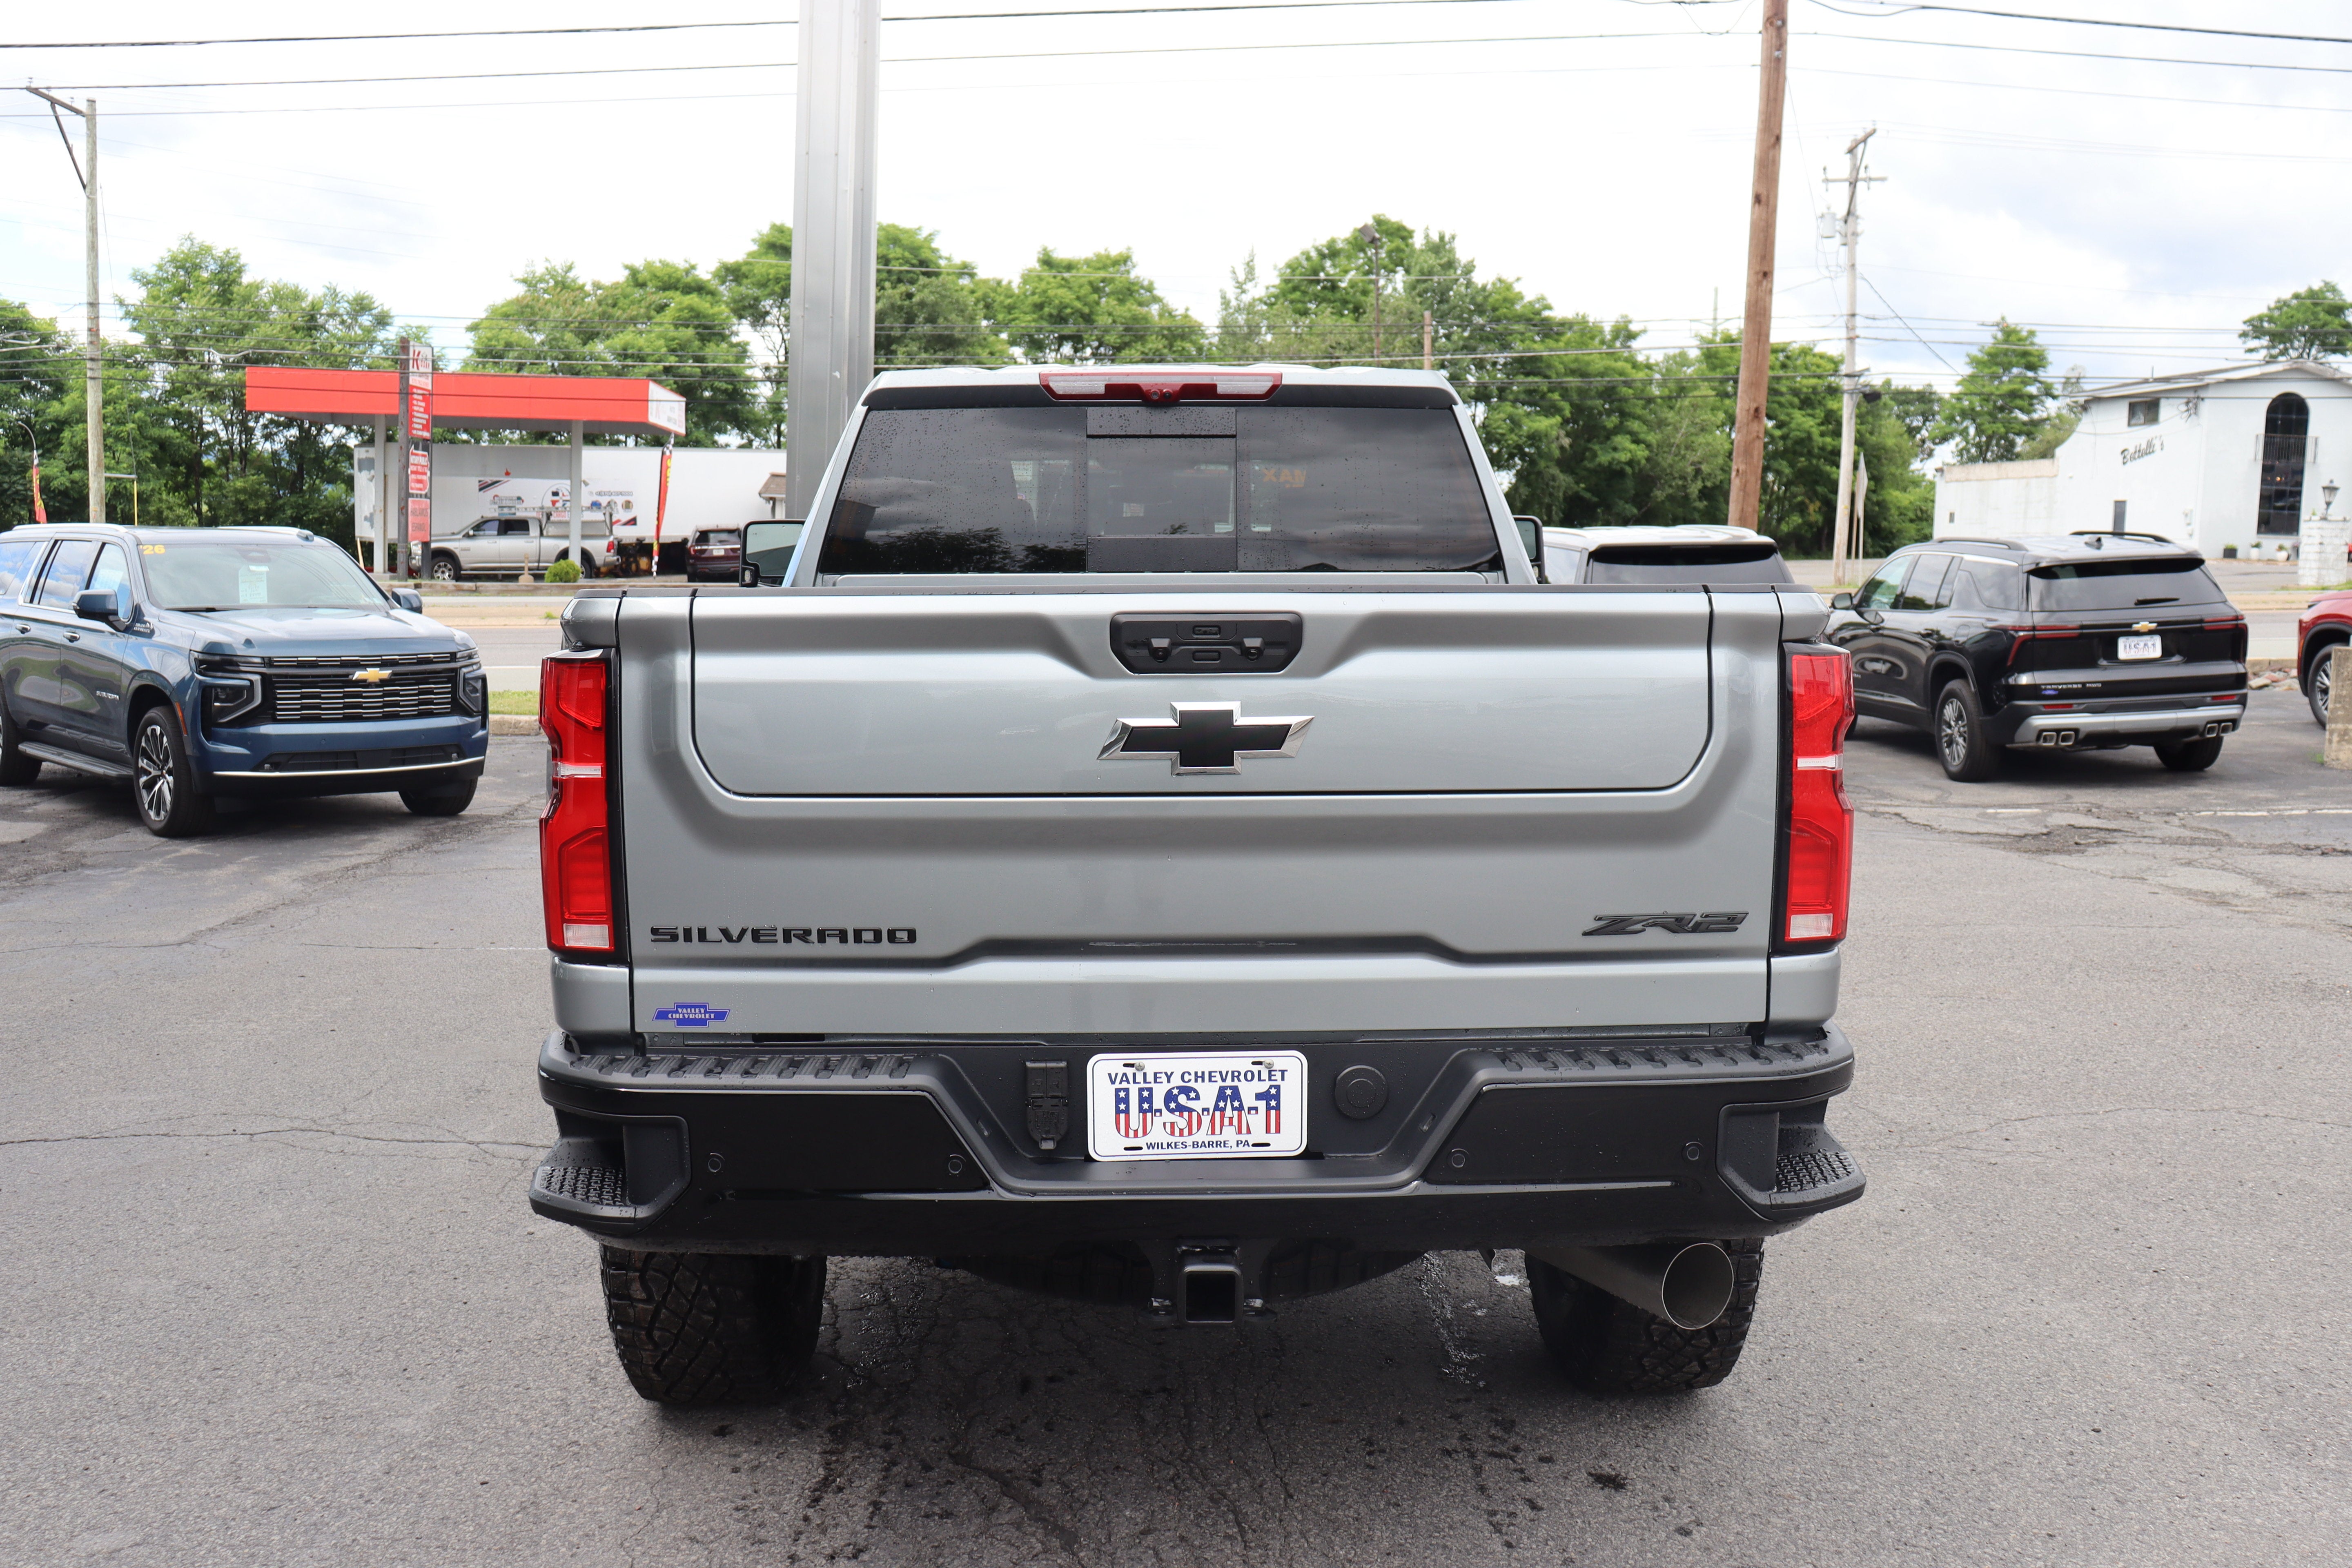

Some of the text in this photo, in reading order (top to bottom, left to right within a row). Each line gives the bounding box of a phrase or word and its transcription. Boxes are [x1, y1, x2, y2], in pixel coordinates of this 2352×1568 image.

[1581, 911, 1749, 936] ZR2
[650, 925, 917, 944] SILVERADO
[1107, 1069, 1288, 1085] VALLEY CHEVROLET
[1146, 1140, 1233, 1150] WILKES-BARRE,
